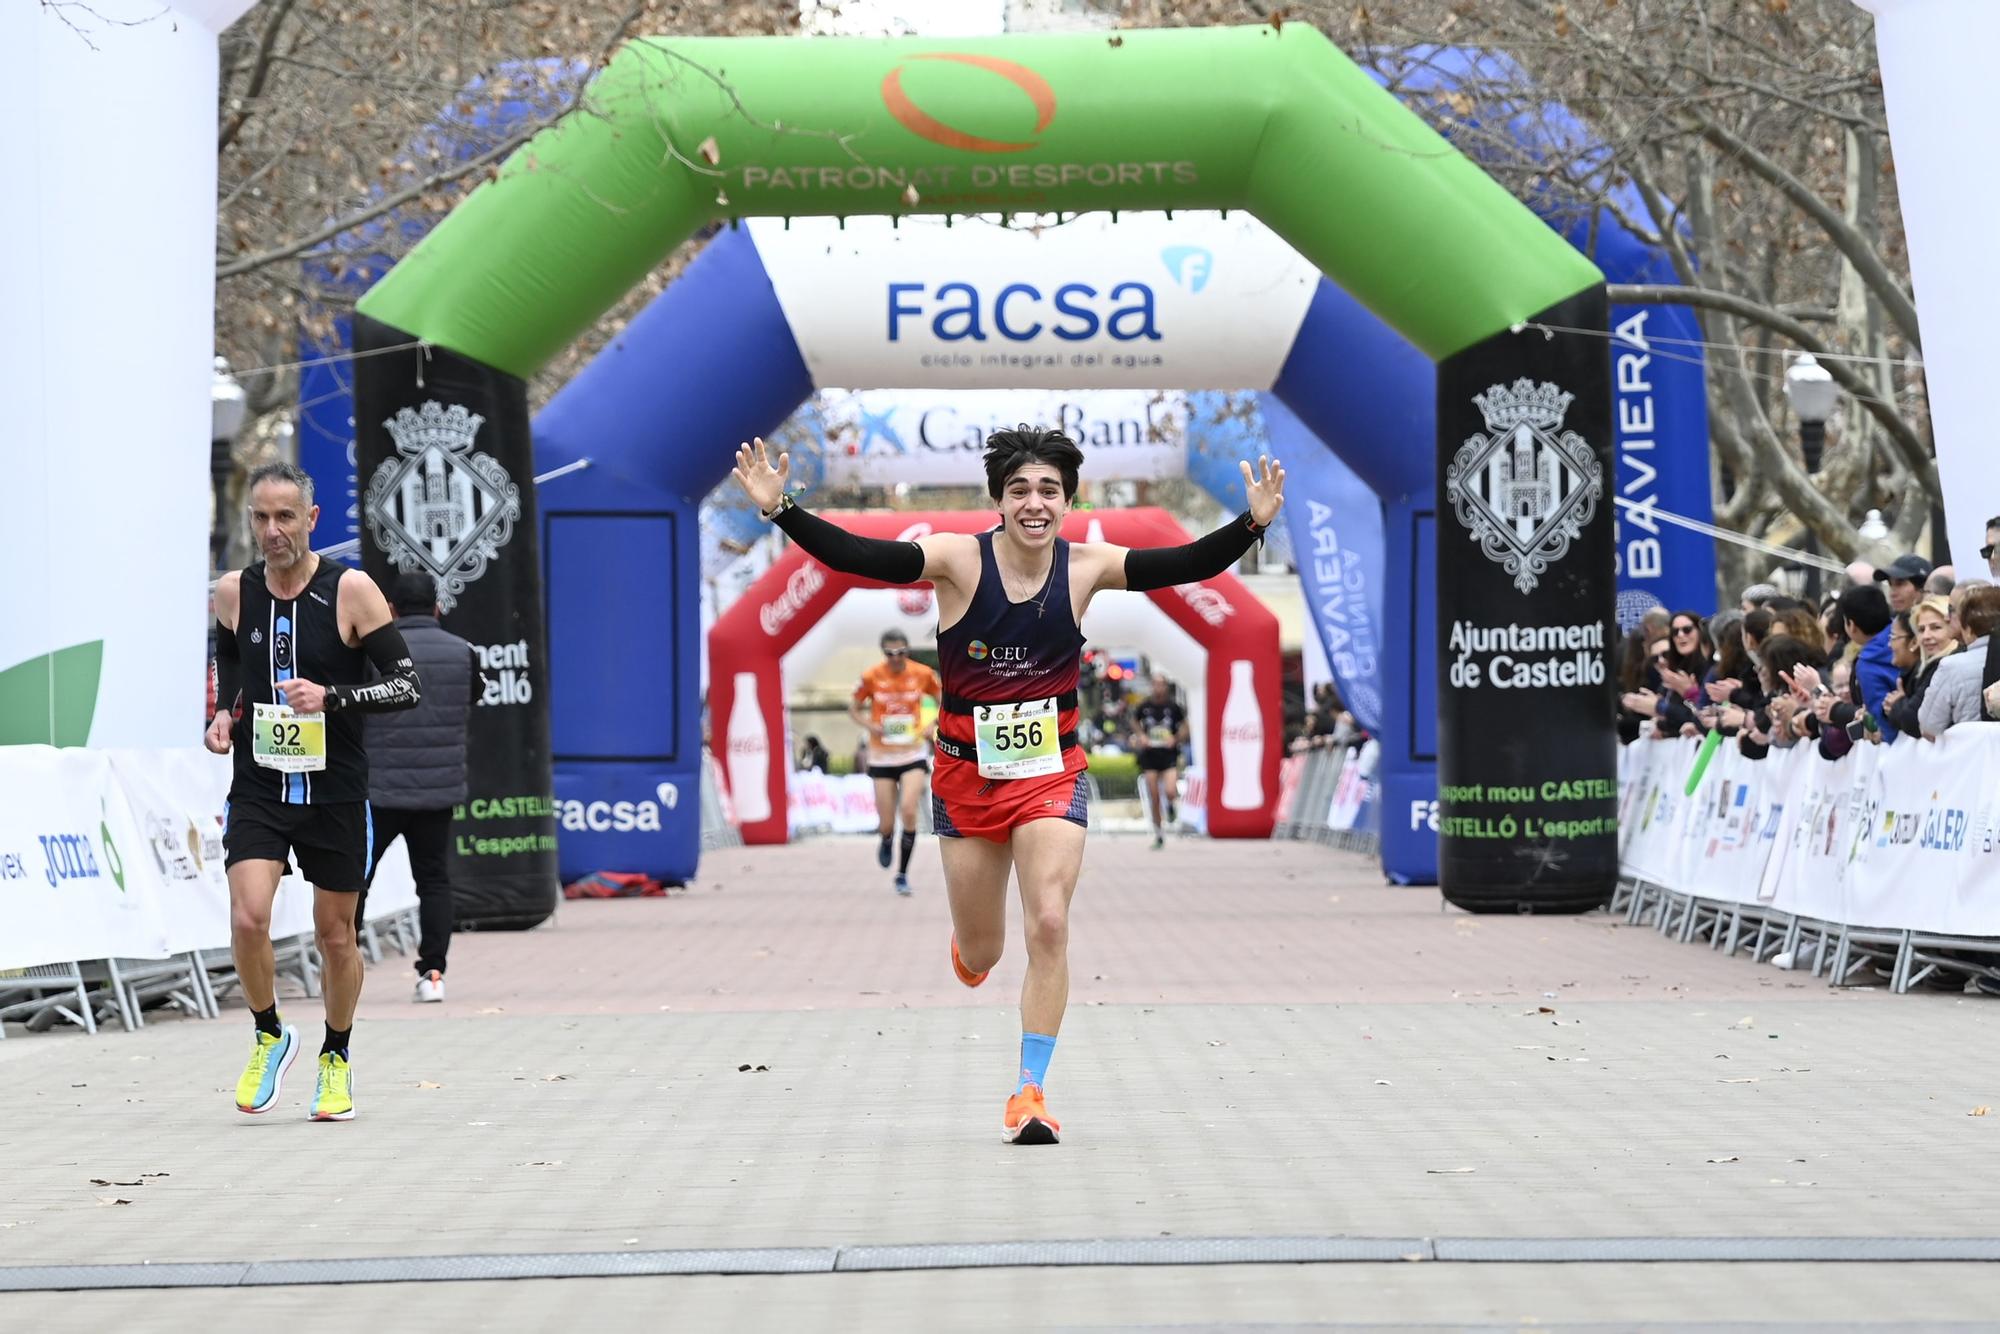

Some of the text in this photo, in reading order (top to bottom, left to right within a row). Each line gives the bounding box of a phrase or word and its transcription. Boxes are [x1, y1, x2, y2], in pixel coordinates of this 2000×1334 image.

[743, 160, 1198, 190] PATRONAT D'ESPORTS
[920, 353, 1164, 369] ciclo integral del agua
[1615, 309, 1663, 578] BAVIERA
[1449, 619, 1604, 661] Ajuntament
[991, 647, 1028, 661] CEU
[1450, 650, 1605, 689] de Castelló
[272, 723, 301, 746] 92
[995, 721, 1043, 751] 556
[268, 746, 306, 756] CARLOS
[1488, 786, 1535, 803] mou
[1540, 779, 1617, 801] CASTELL
[470, 796, 554, 819] CASTELL
[1525, 817, 1602, 840] L'esport
[456, 832, 537, 857] L'esport
